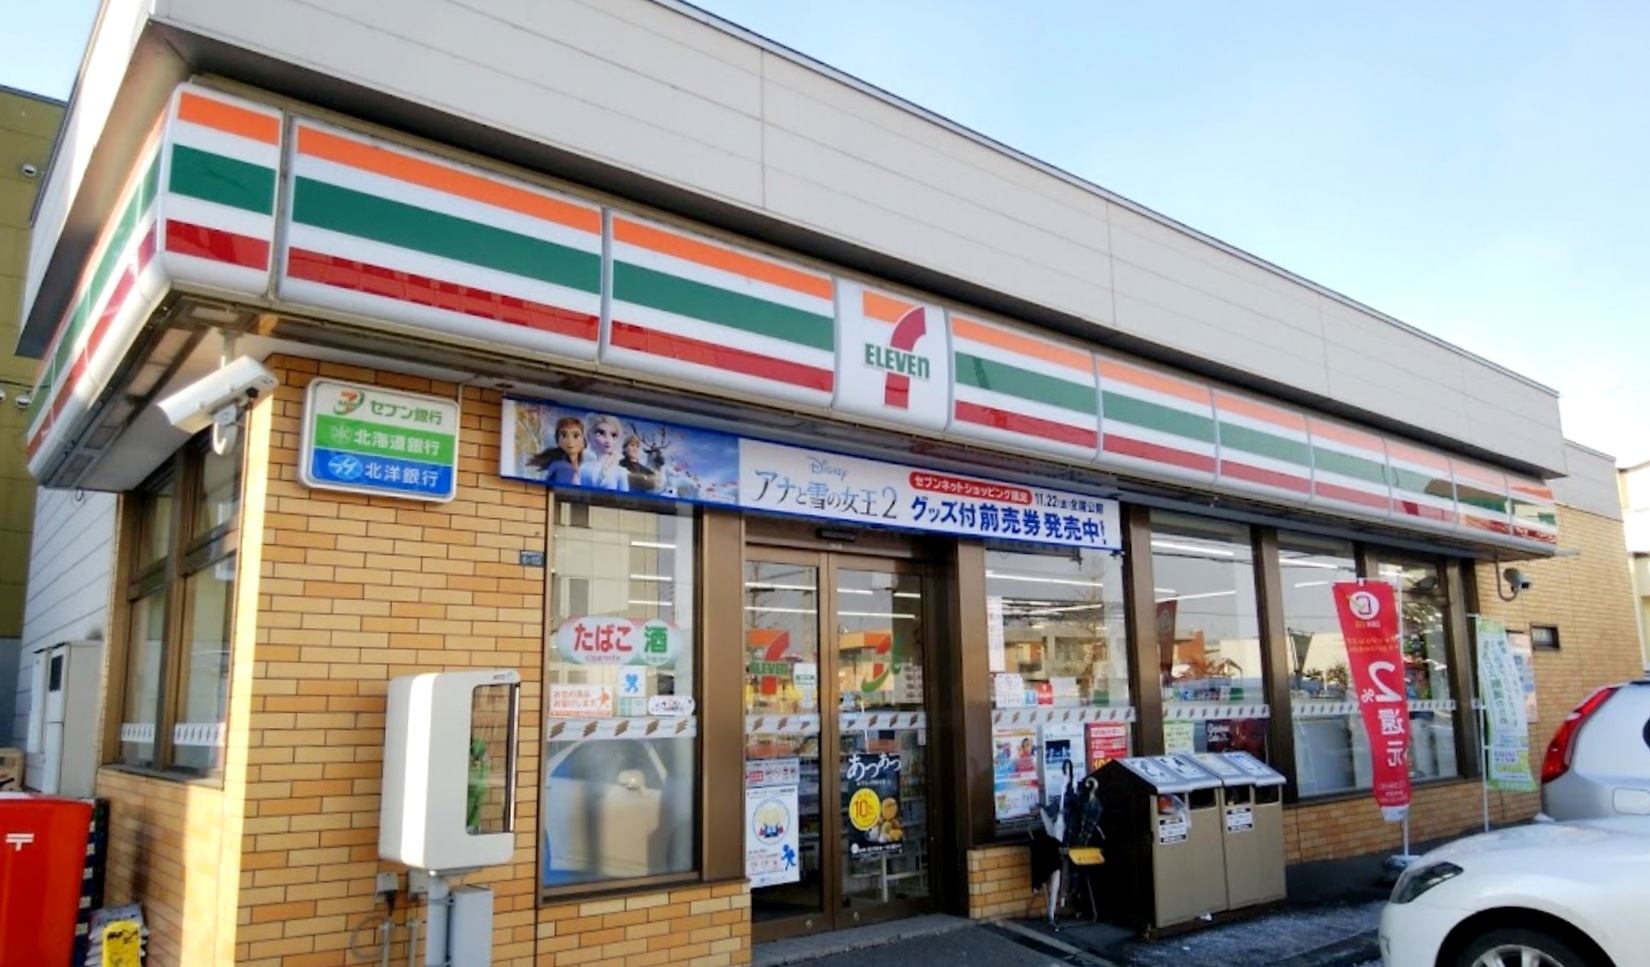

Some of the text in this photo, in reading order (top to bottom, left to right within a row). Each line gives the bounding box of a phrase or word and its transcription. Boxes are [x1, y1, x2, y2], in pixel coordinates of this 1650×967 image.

[370, 400, 443, 426] セブン銀行
[354, 428, 441, 456] 北海道銀行
[364, 461, 439, 488] 北洋銀行
[574, 622, 668, 653] たばこ 酒
